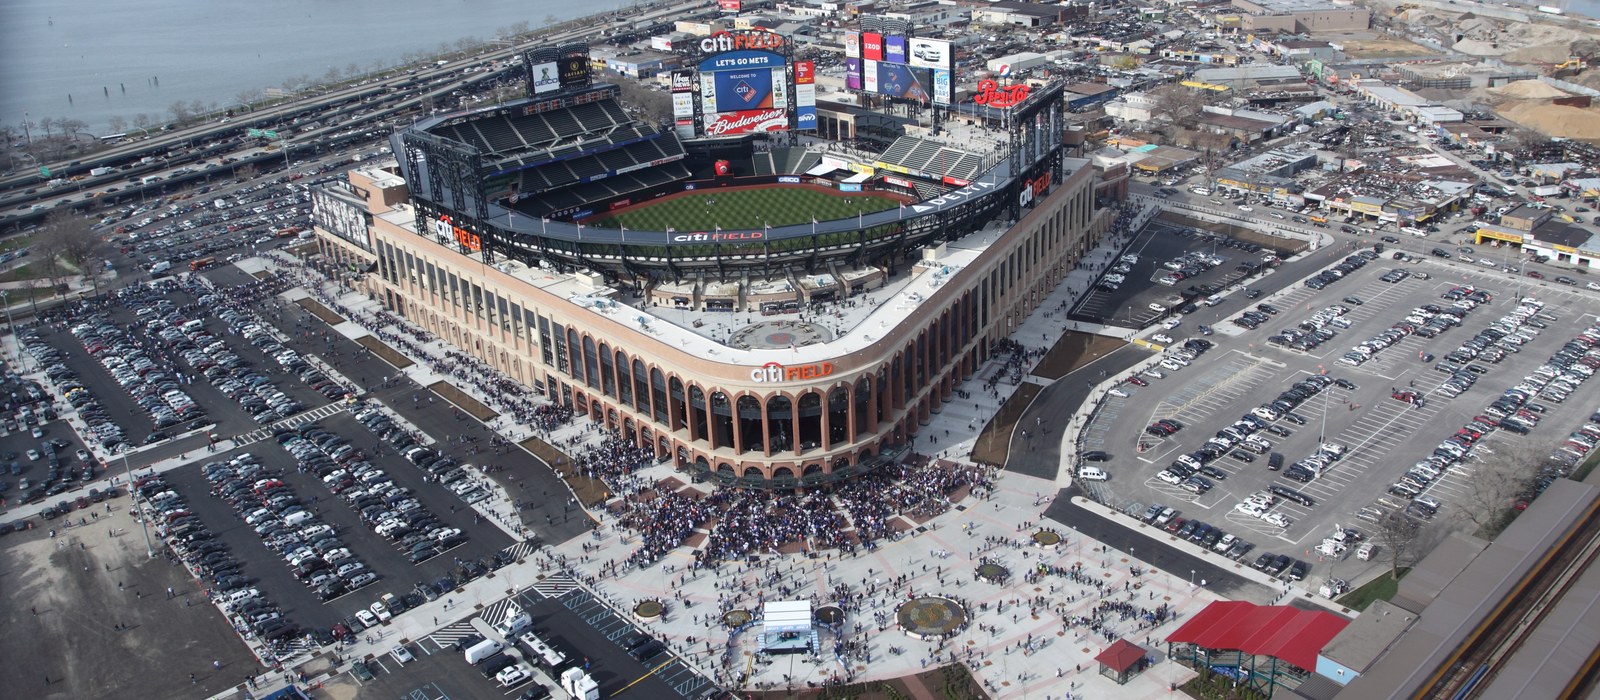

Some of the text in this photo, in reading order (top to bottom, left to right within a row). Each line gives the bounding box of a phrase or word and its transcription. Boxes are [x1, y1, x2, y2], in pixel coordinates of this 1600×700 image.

[701, 34, 781, 52] citi FIELD
[716, 59, 736, 67] LET'S
[535, 78, 558, 87] GEICO
[714, 108, 784, 135] Budweiser
[928, 182, 994, 206] DELTA
[1020, 171, 1051, 207] citi FIELD
[454, 226, 481, 251] FIELD
[674, 232, 763, 241] citi FIELD
[751, 361, 833, 383] citi FIELD
